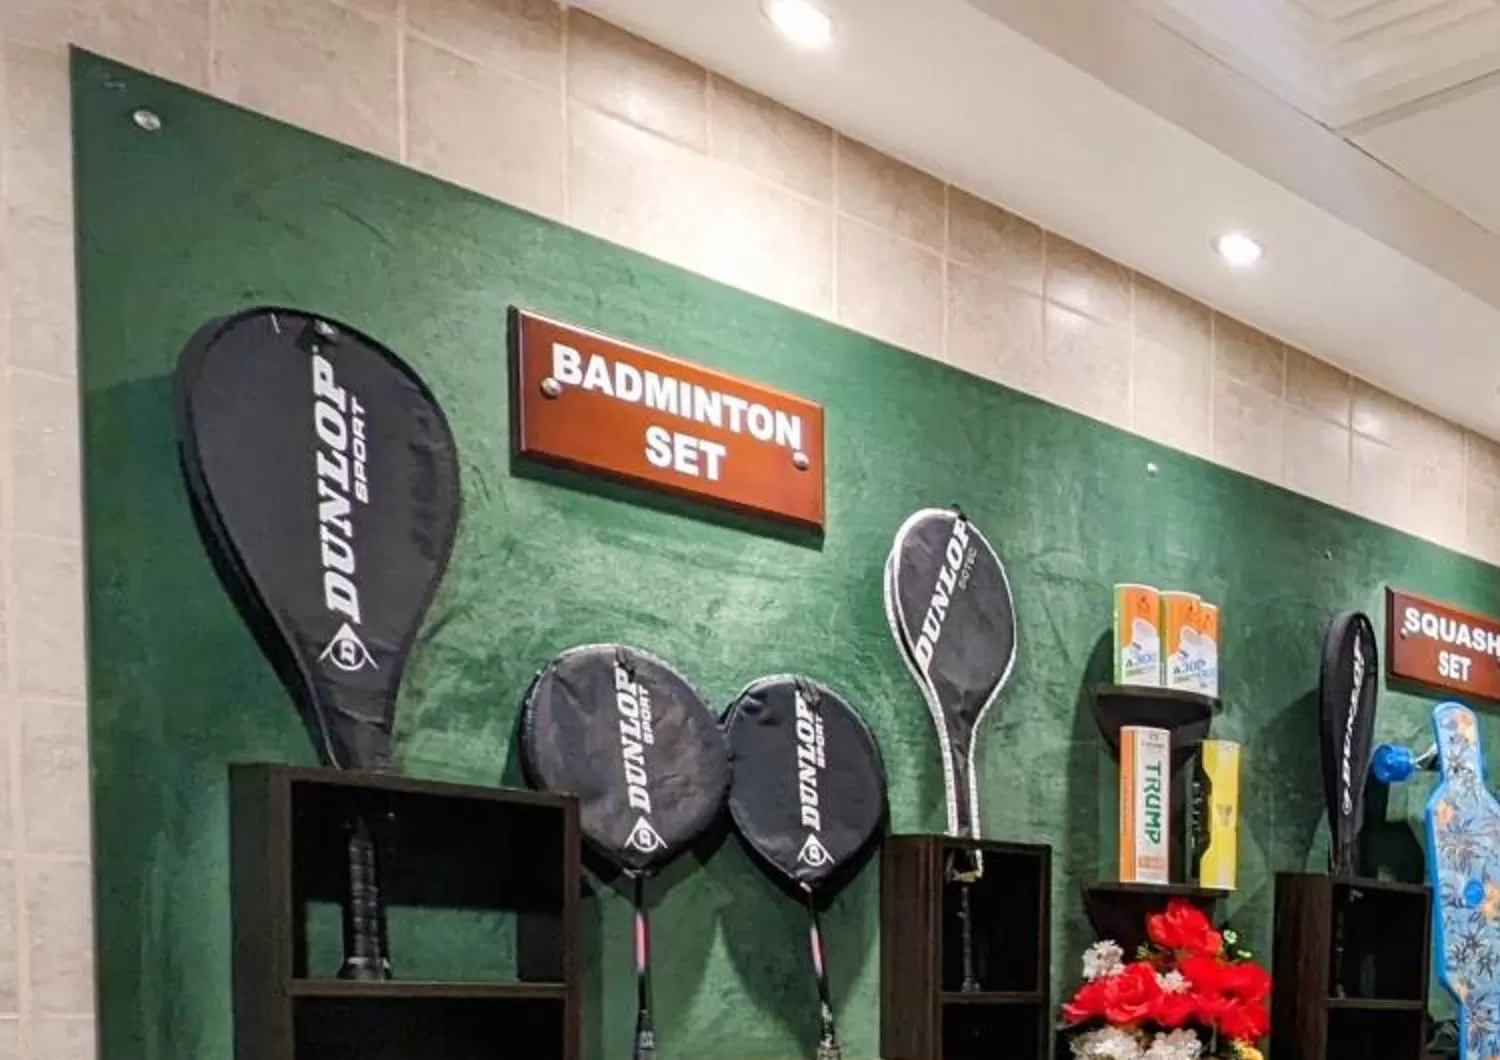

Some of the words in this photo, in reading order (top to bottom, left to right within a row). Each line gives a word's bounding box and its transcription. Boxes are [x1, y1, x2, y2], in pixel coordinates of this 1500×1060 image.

[351, 396, 369, 504] SPORT
[552, 342, 801, 450] BADMINTON
[312, 354, 361, 625] DUNLOP
[645, 426, 726, 481] SET
[916, 519, 969, 672] DUNLOP
[635, 685, 655, 745] SPORT
[1438, 650, 1472, 681] SET
[615, 667, 651, 814] DUNLOP
[795, 698, 821, 832] DUNLOP
[1143, 760, 1162, 845] TRUMP
